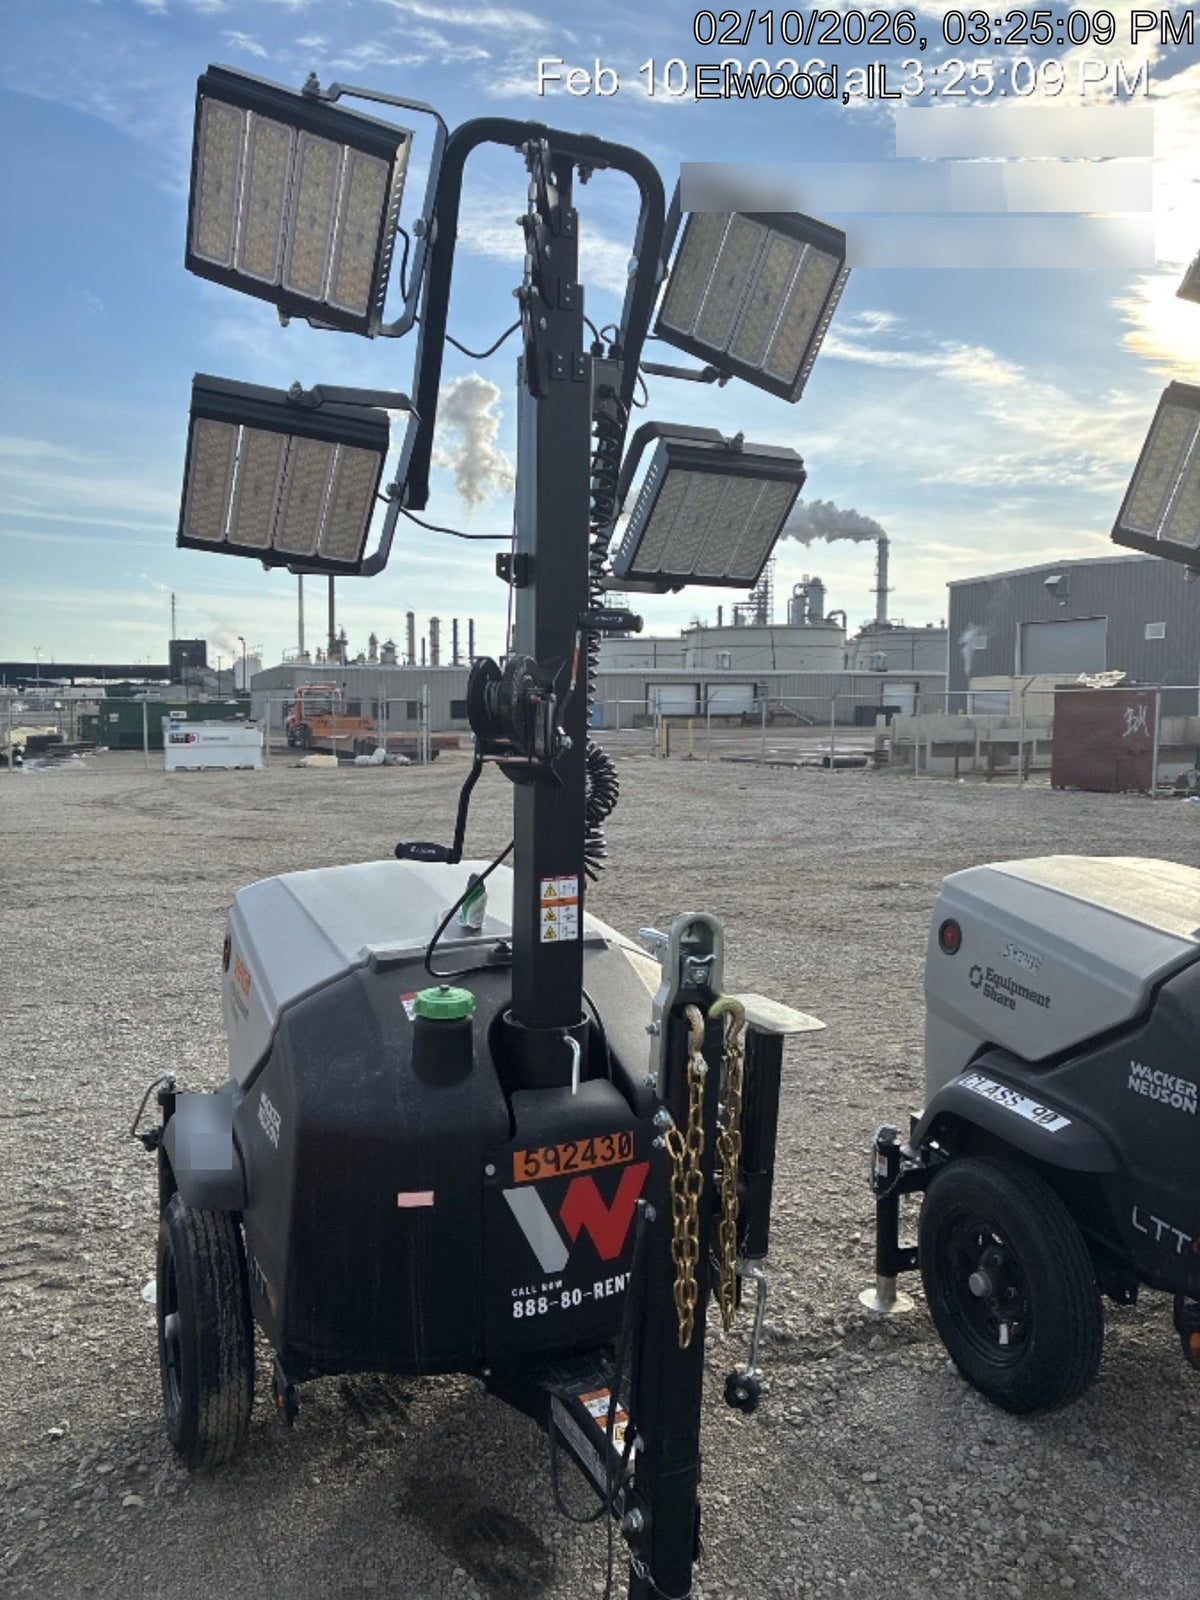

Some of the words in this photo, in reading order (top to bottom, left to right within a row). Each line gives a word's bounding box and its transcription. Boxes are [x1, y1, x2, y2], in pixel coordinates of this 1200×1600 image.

[983, 982, 1017, 1011] Share
[985, 966, 1052, 1009] Equipment
[1127, 1075, 1198, 1115] NEUSON
[1129, 1060, 1198, 1099] WACKER
[523, 1132, 632, 1178] 592430
[511, 1285, 538, 1297] CALL
[541, 1279, 563, 1292] NOW
[512, 1272, 632, 1318] 888-80-RENT
